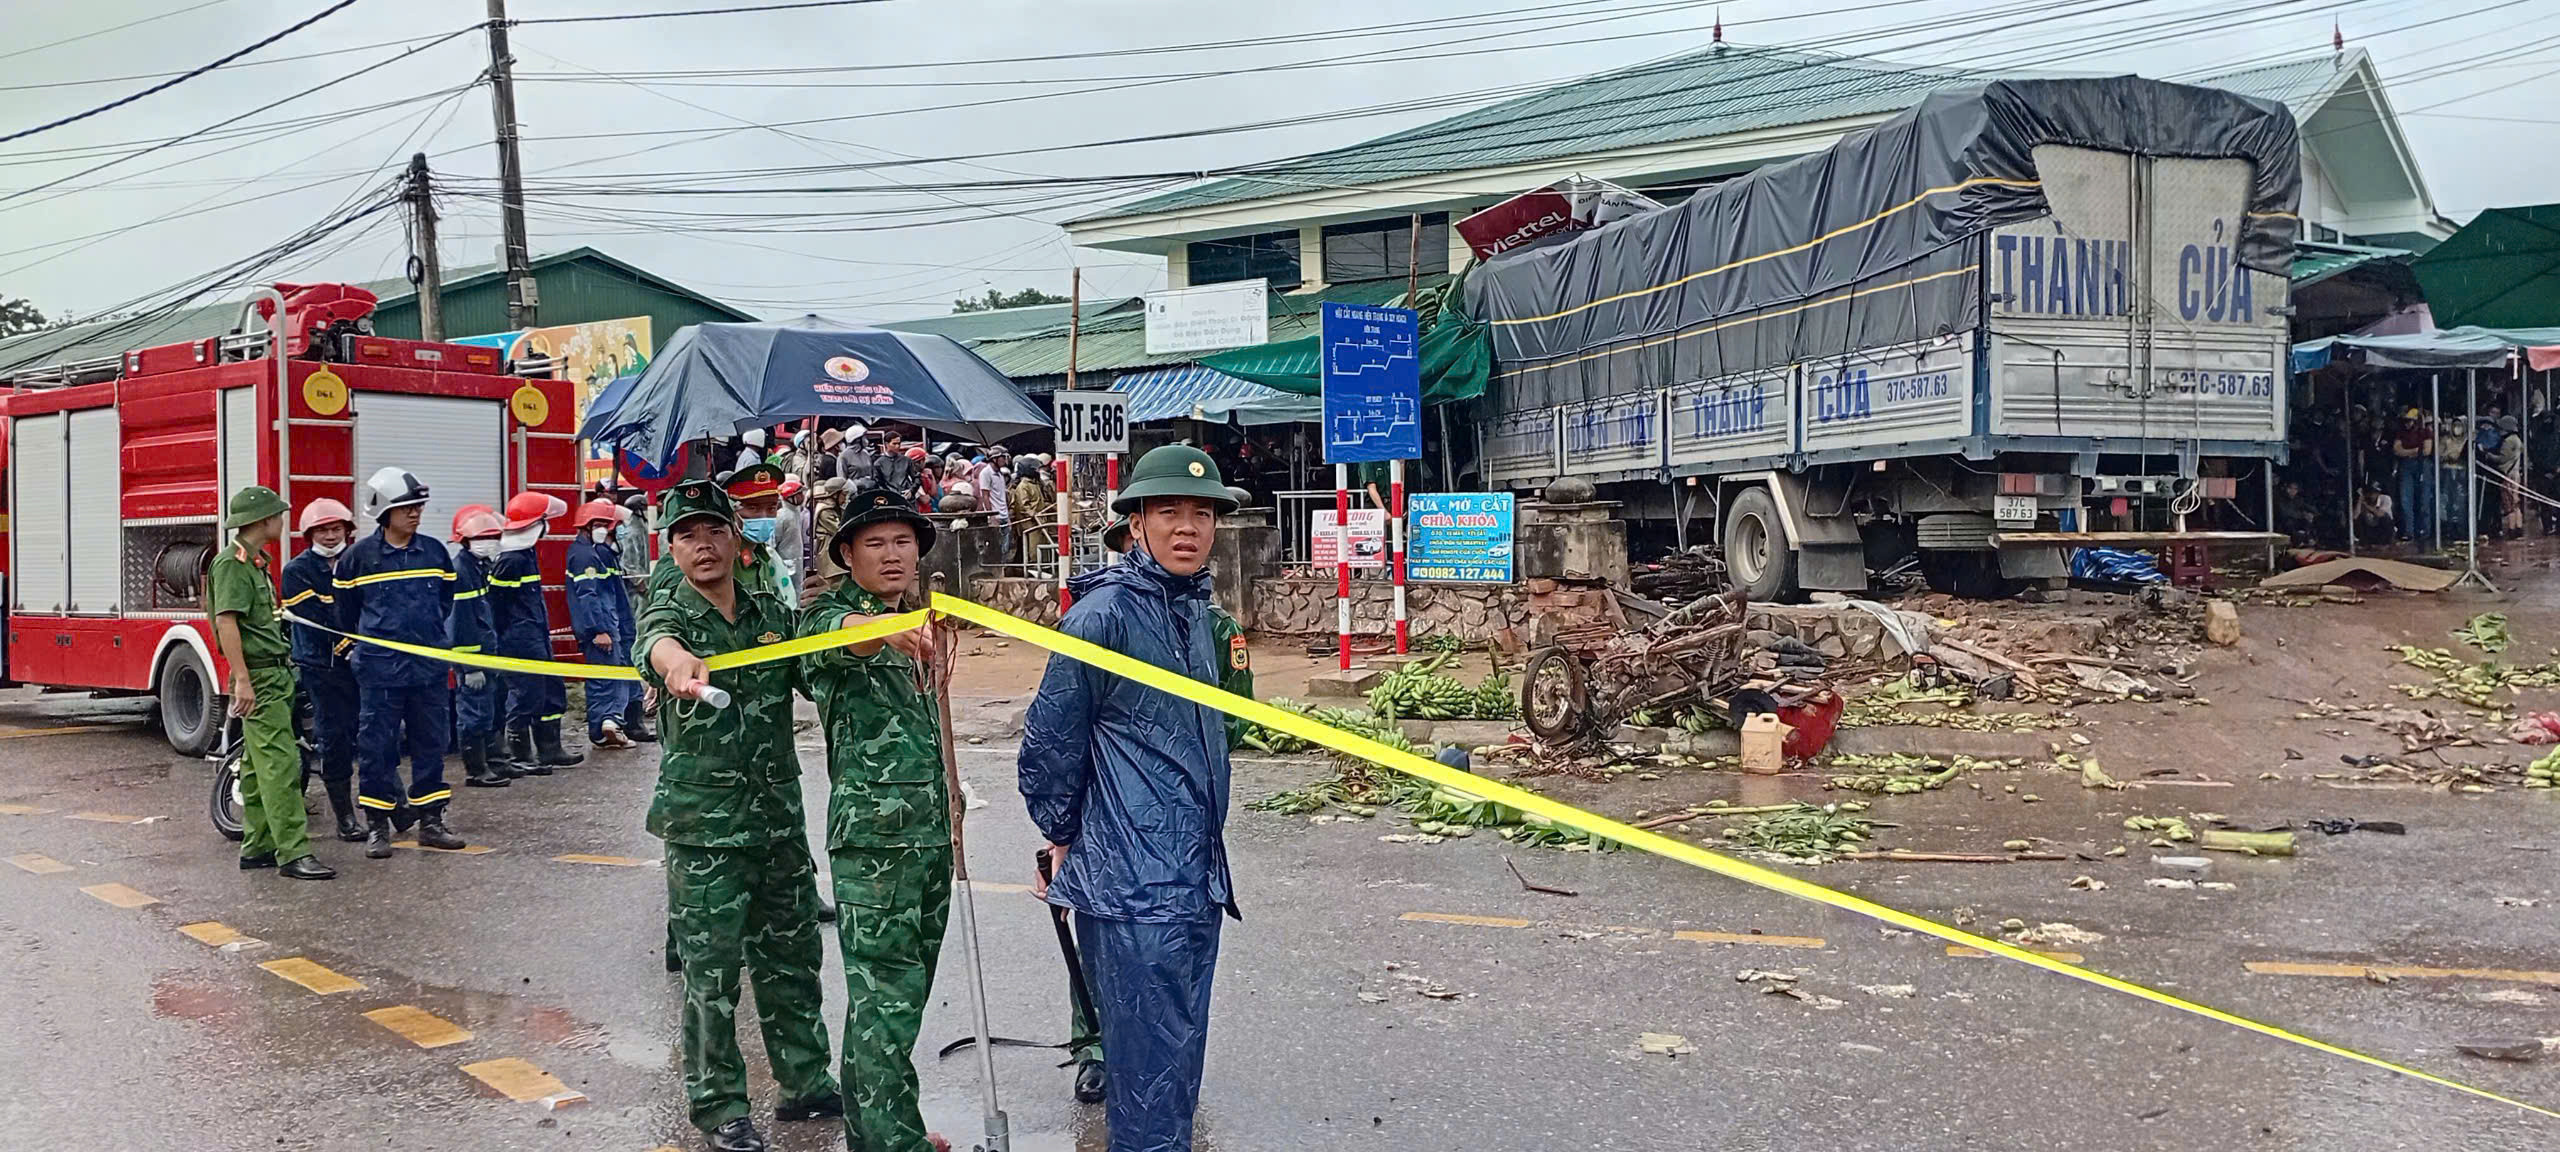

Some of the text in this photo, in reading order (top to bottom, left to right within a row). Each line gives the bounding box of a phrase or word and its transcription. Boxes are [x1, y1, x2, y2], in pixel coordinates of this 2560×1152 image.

[1482, 211, 1567, 256] Viettel
[1997, 217, 2254, 323] THÀNH CỦA
[2178, 371, 2273, 398] 37C-587.63
[1060, 403, 1124, 442] ĐT.586
[1410, 496, 1439, 512] SỬA
[1448, 497, 1472, 512] MỞ
[1481, 494, 1510, 512] CẮT
[1421, 513, 1497, 527] CHÌA KHÓA
[1428, 567, 1505, 580] 0982.127.444
